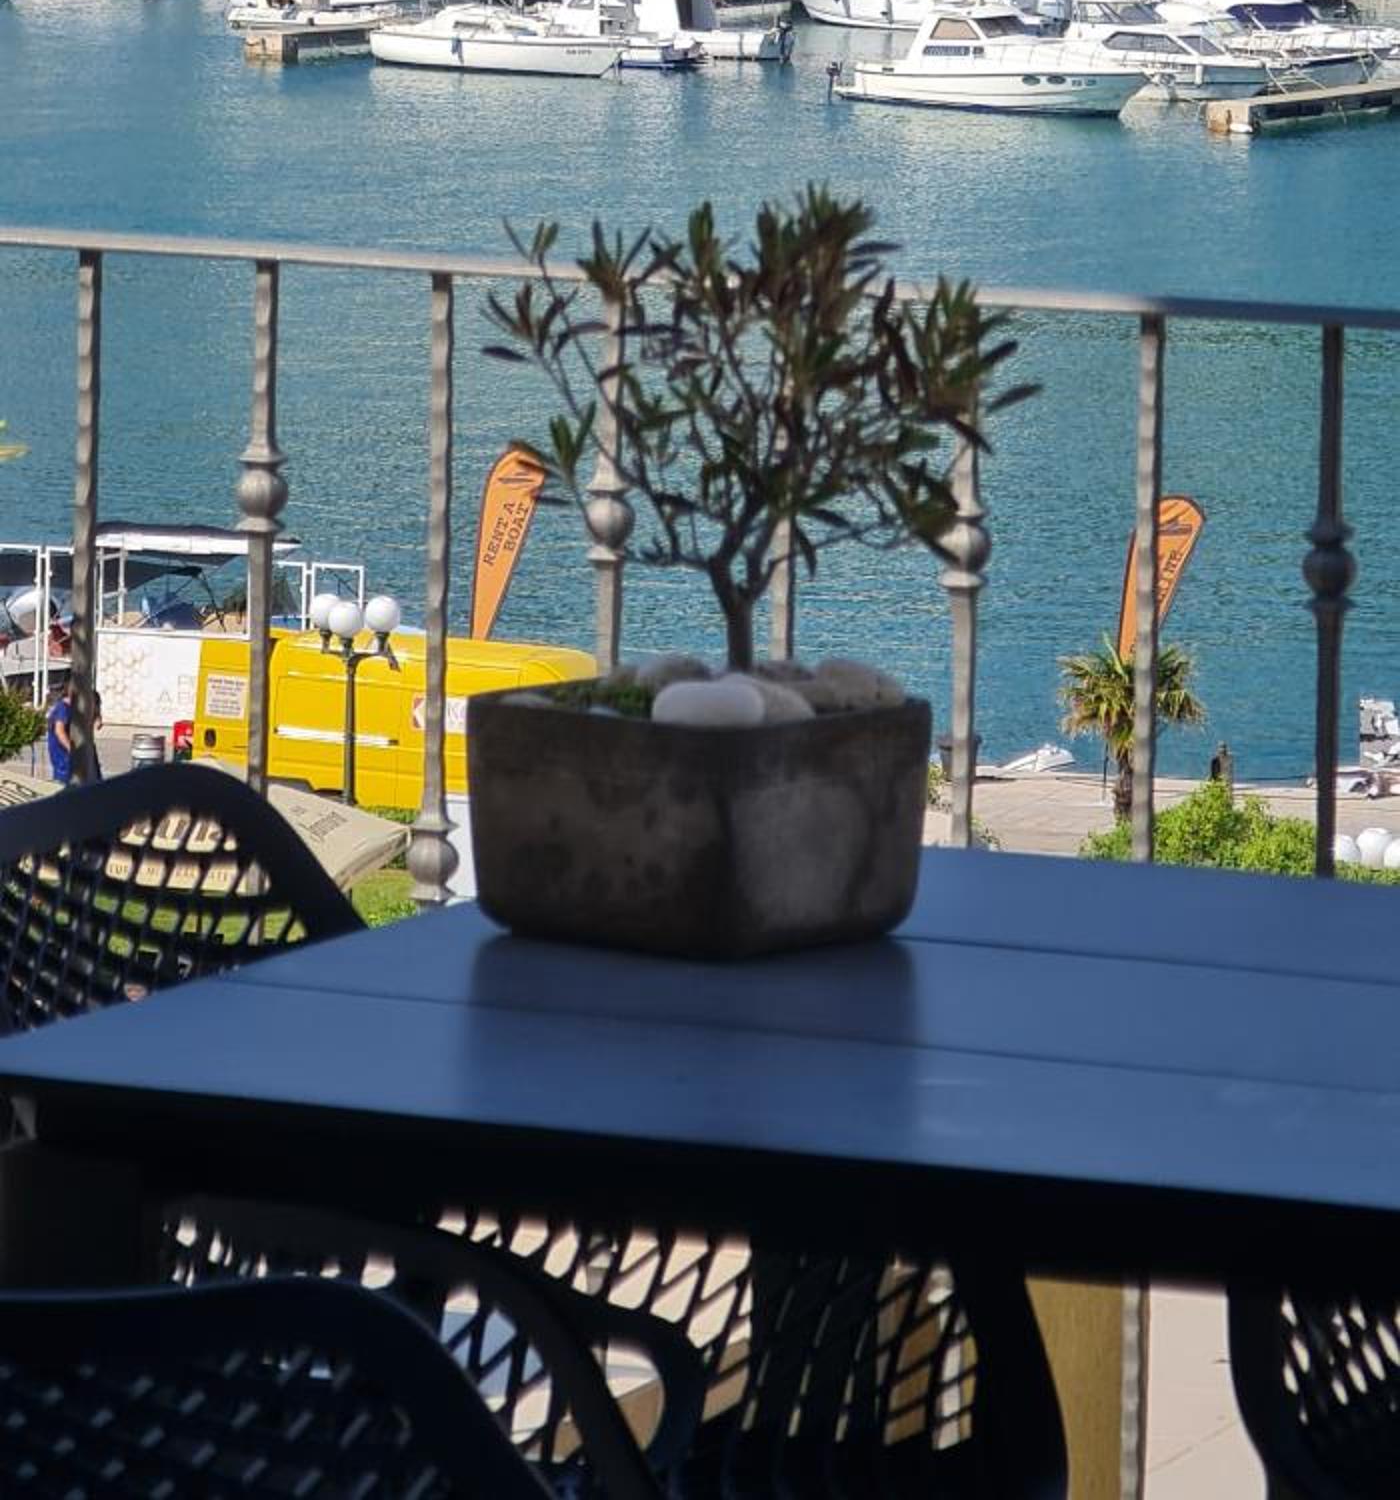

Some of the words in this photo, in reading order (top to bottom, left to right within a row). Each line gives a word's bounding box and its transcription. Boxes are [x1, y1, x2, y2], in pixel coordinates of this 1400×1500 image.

[483, 516, 509, 567] RENT
[503, 502, 516, 516] A
[503, 501, 530, 552] BOAT
